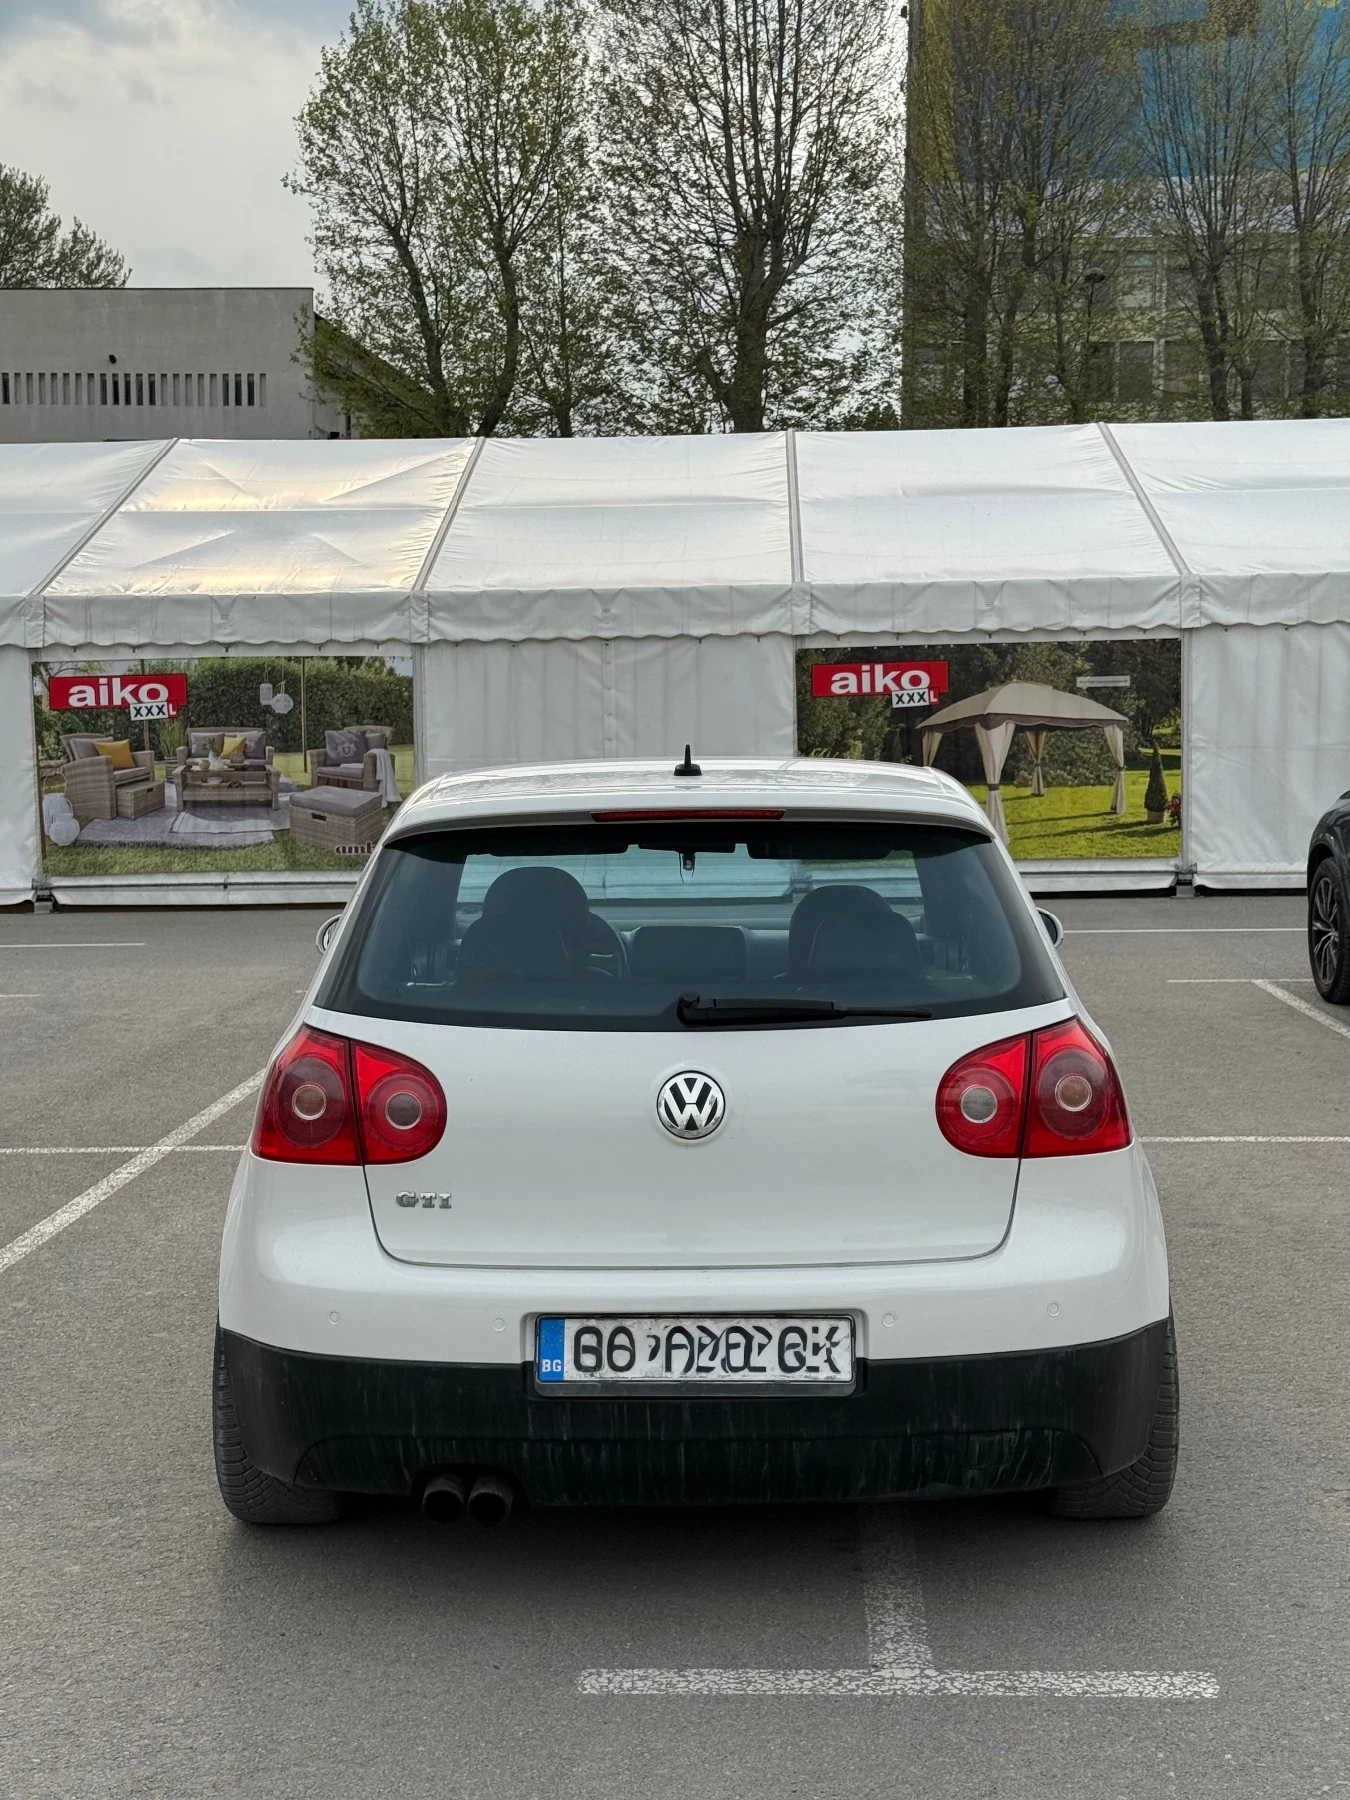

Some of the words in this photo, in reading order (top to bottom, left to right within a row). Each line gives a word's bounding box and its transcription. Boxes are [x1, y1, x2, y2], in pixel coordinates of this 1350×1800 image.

[830, 664, 931, 694] aiko
[68, 677, 169, 707] aiko
[395, 1191, 452, 1209] GTI
[541, 1358, 562, 1373] BG
